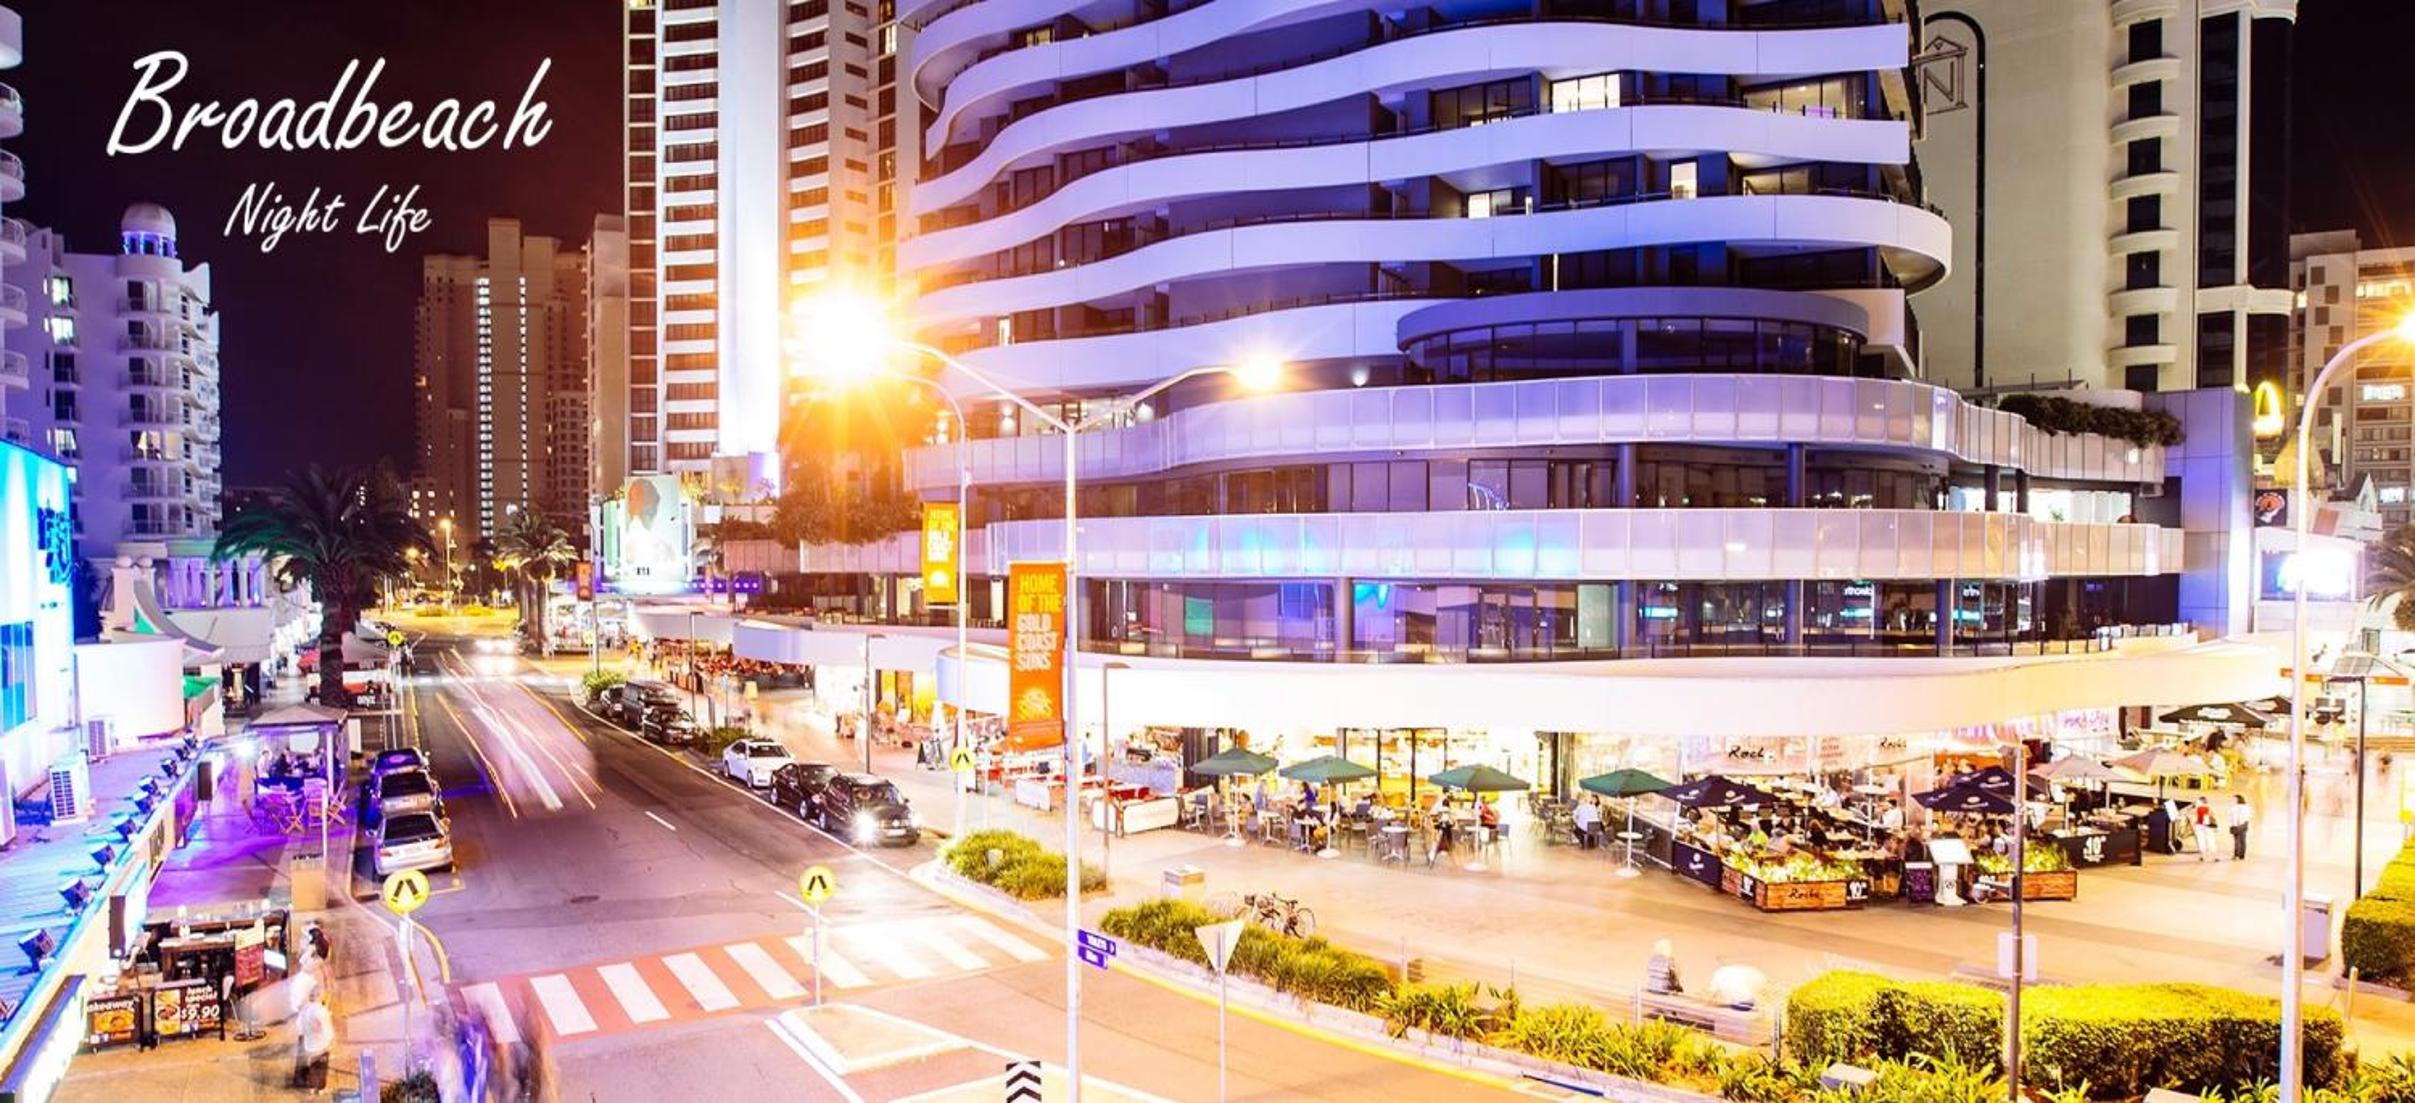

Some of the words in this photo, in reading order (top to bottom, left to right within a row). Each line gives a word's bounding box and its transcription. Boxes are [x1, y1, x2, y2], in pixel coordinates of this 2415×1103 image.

[1019, 573, 1058, 593] HOME
[1018, 594, 1036, 613] OF
[1038, 594, 1062, 613] THE
[1016, 613, 1052, 632] GOLD
[1016, 632, 1058, 652] COAST
[1015, 652, 1052, 671] SUNS
[86, 1000, 135, 1013] akeaway
[181, 1004, 220, 1020] $9.90
